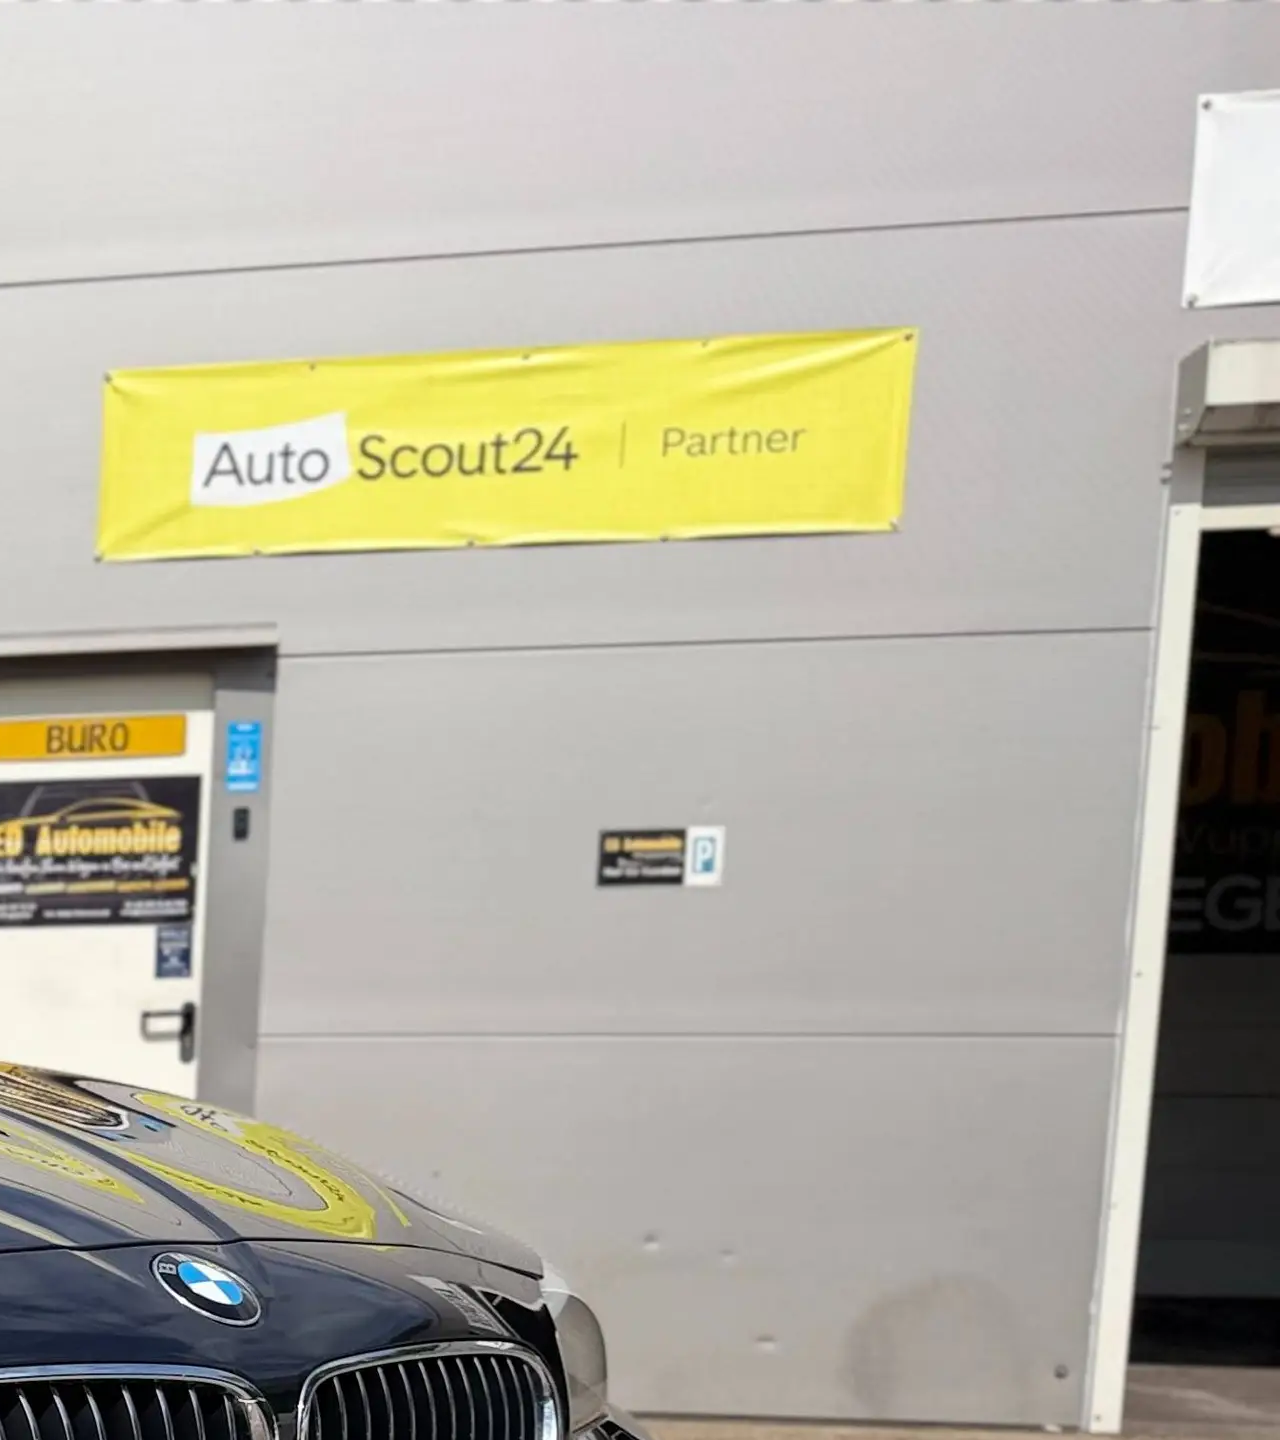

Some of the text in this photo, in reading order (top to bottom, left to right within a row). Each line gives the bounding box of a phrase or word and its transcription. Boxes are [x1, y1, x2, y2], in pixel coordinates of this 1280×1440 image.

[201, 421, 808, 489] Auto Scout24 Partner
[35, 817, 183, 857] Automobile
